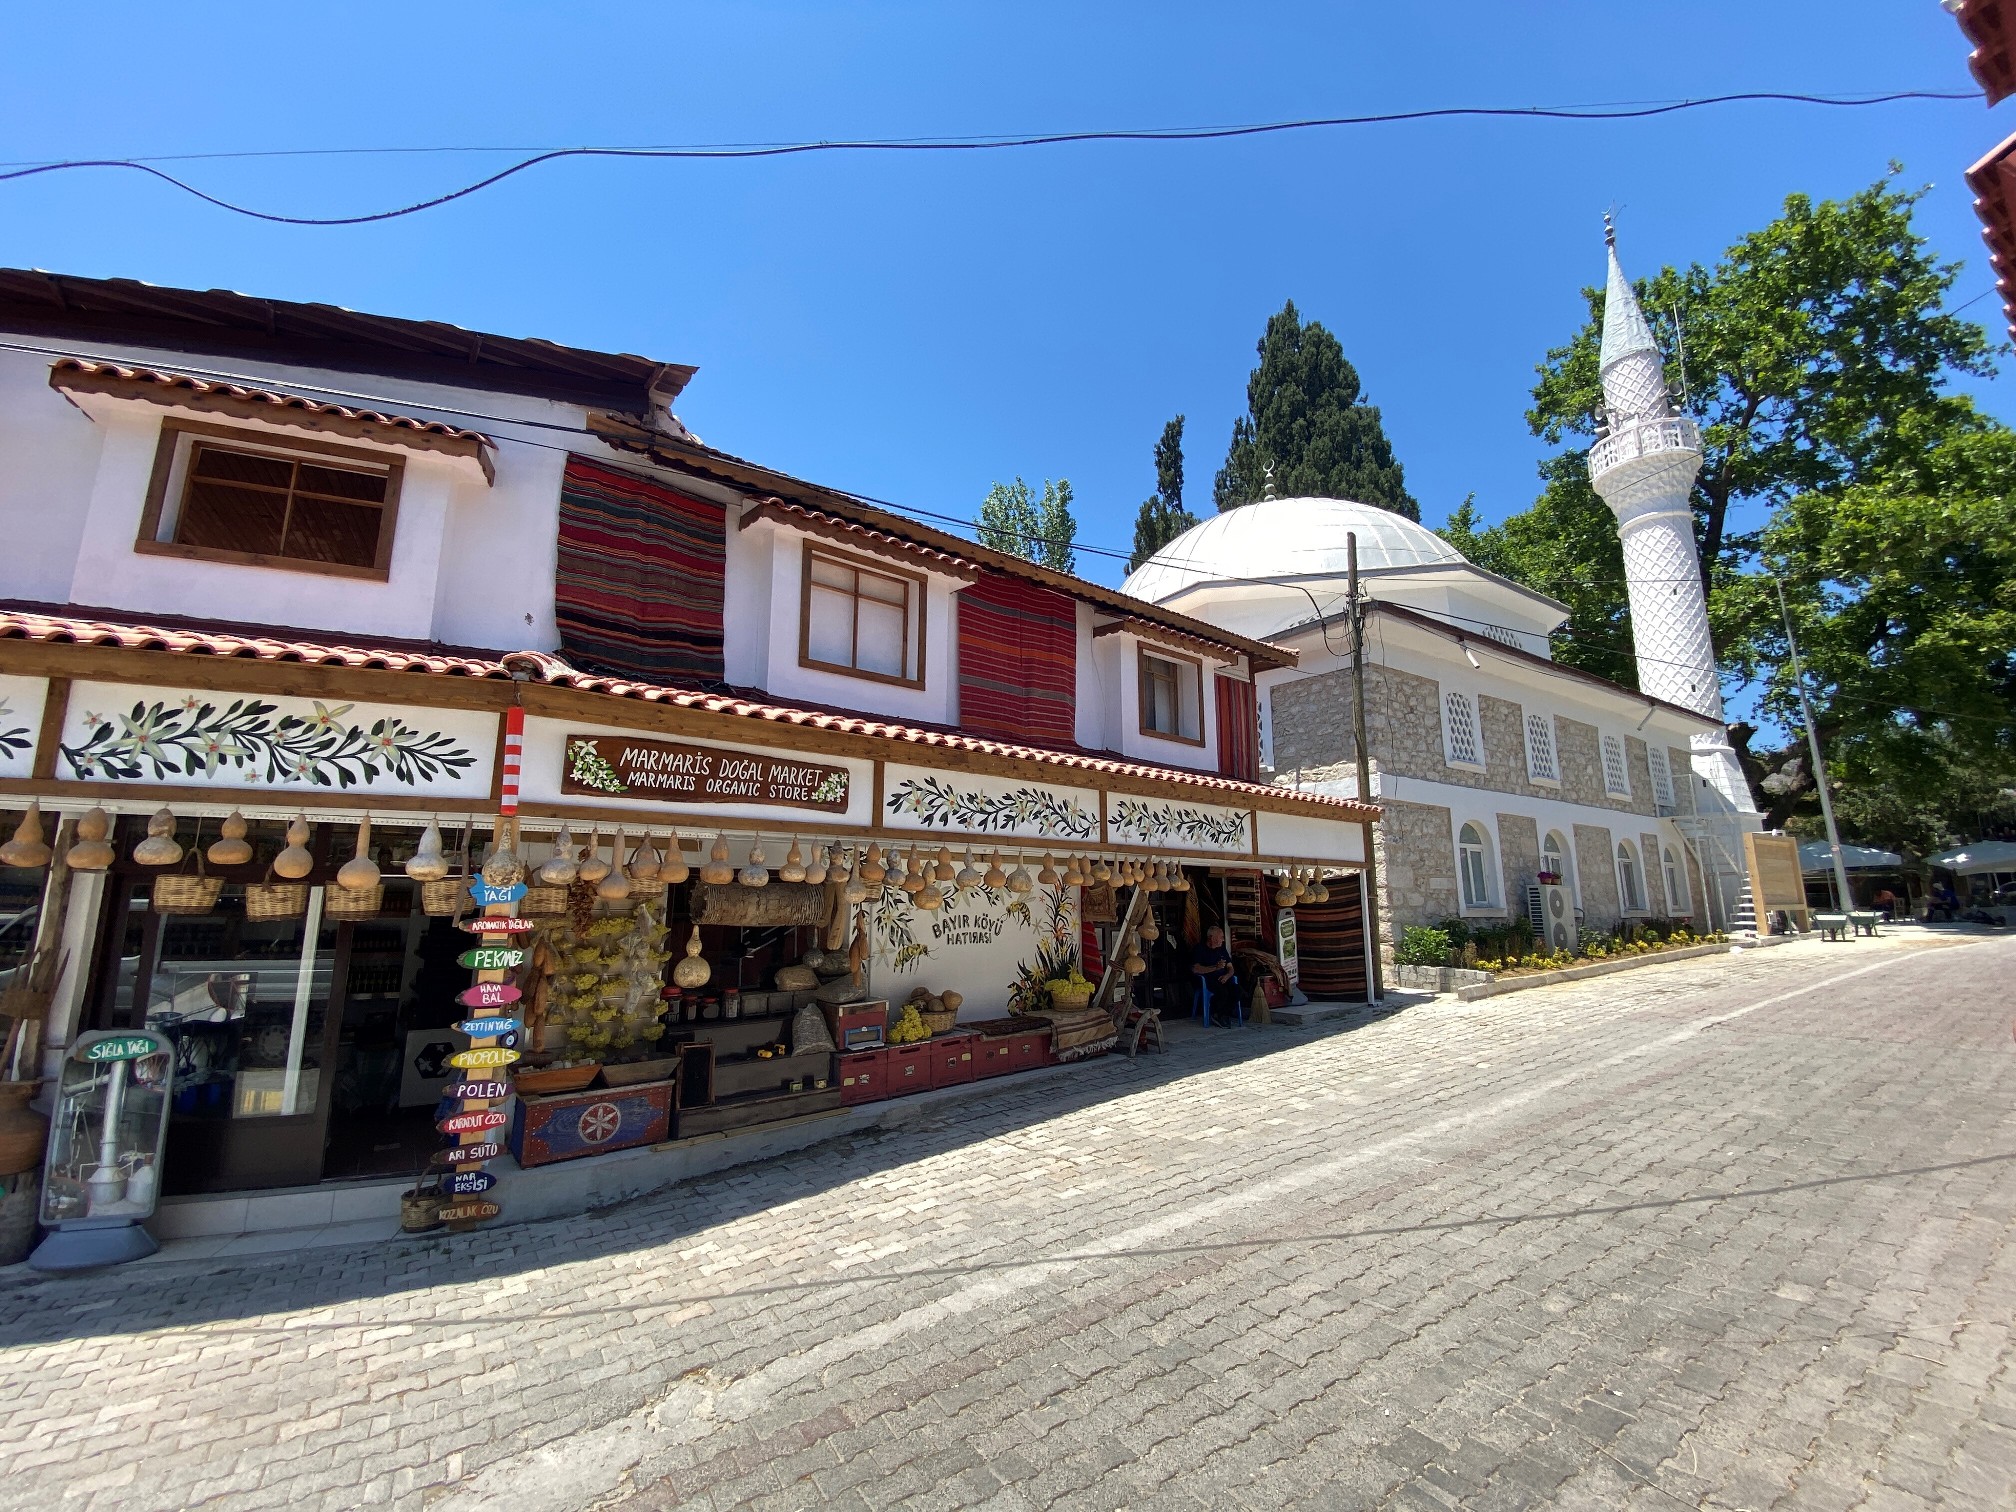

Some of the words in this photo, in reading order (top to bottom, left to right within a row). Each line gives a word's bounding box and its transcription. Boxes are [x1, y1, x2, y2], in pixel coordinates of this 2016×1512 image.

[619, 747, 712, 775] MARMARİS
[719, 758, 763, 781] DOĞAL
[768, 764, 823, 787] MARKET
[626, 771, 696, 791] MARMARIS
[706, 778, 760, 796] ORGANIC
[769, 785, 809, 801] STORE
[932, 915, 970, 938] BAYIR
[974, 912, 1003, 937] KÖYÜ
[475, 950, 523, 967] PEKMEZ
[480, 984, 502, 994] HAM
[482, 992, 505, 1005] BAL
[457, 1083, 507, 1097] POLEN
[449, 1115, 484, 1130] KARADUT
[448, 1150, 466, 1162] ARI
[455, 1172, 477, 1182] NAR
